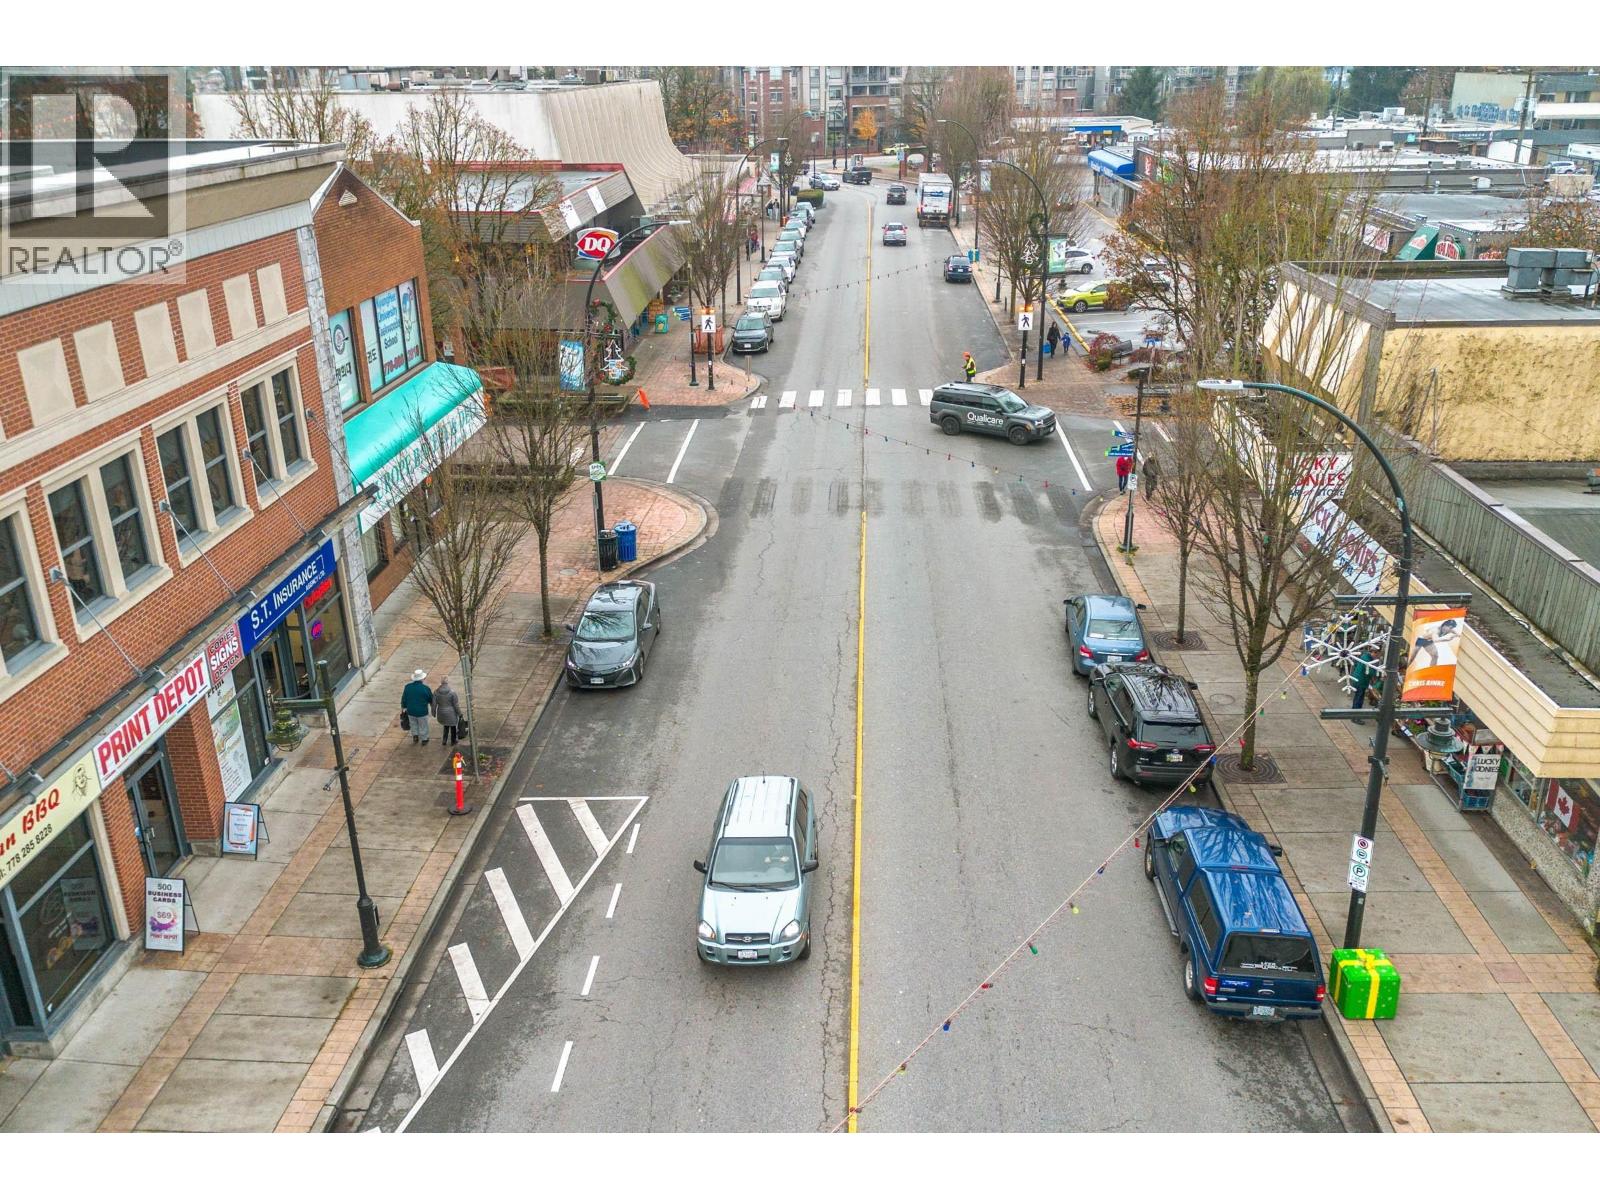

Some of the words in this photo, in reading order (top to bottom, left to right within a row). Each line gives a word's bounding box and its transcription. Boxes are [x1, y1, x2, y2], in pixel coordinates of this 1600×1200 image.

[584, 237, 611, 253] DQ
[384, 334, 398, 349] School
[967, 411, 1004, 426] Qualicare
[251, 600, 272, 629] S.T.
[210, 628, 235, 654] COPIES
[211, 637, 239, 671] SIGNS
[214, 655, 240, 680] DESIGN
[98, 703, 150, 775] PRINT
[153, 657, 205, 725] DEPOT
[1476, 757, 1500, 767] LUCKY
[22, 788, 61, 834] BBQ
[7, 853, 21, 872] 778
[21, 840, 36, 858] 285
[148, 890, 182, 898] BUSINESS
[157, 883, 172, 891] 500
